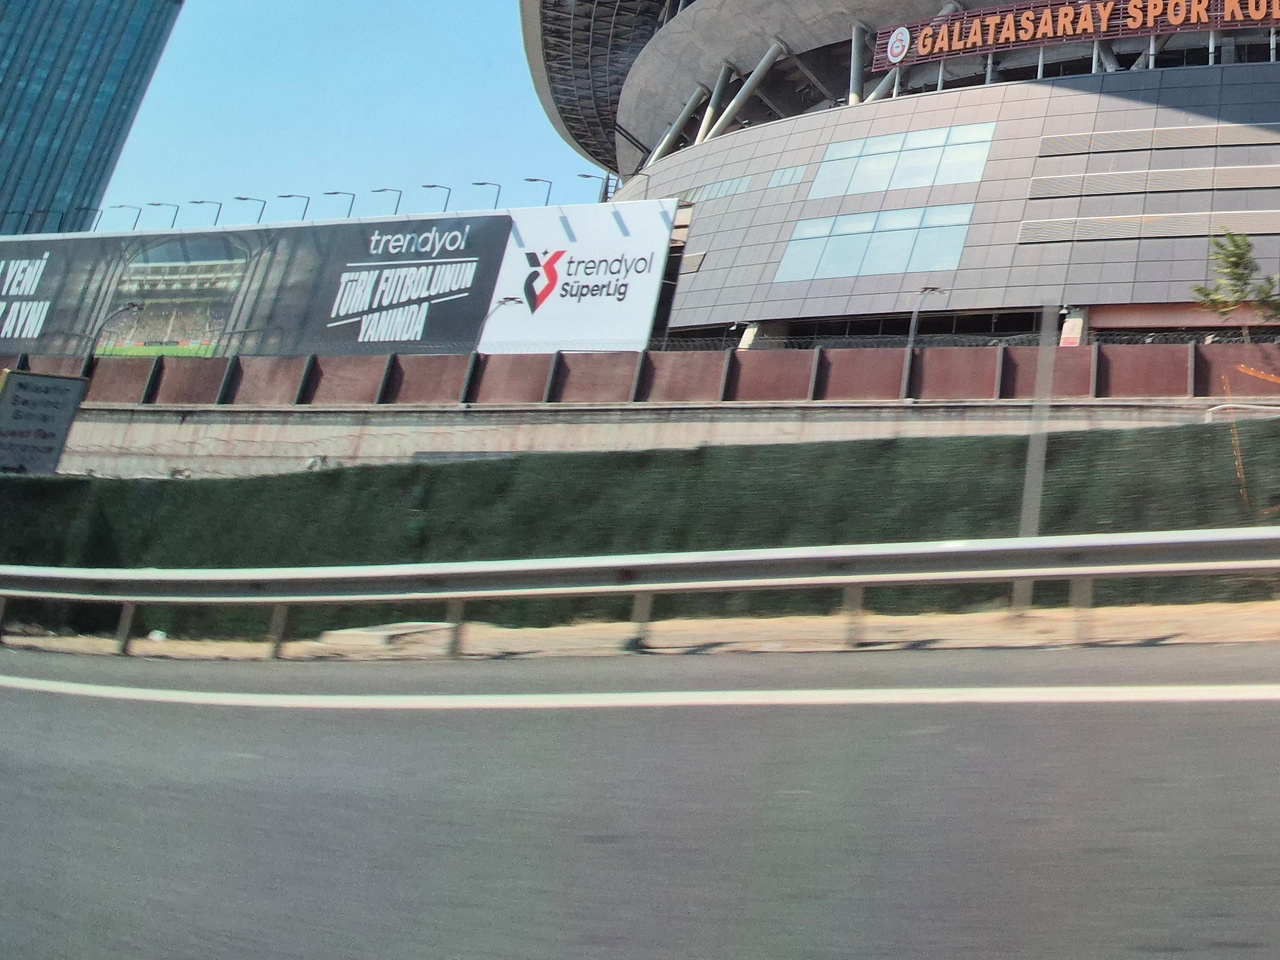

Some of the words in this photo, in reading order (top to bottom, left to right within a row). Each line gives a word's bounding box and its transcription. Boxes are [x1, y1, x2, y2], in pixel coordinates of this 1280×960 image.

[917, 1, 1115, 56] GALATASARAY
[369, 224, 471, 257] trendyol
[1, 251, 50, 296] YENİ
[566, 251, 655, 280] trendyol
[330, 269, 380, 318] TÜRK
[371, 261, 478, 309] FUTBOLUNUN
[0, 301, 51, 339] AYNI
[358, 301, 430, 342] YANINDA
